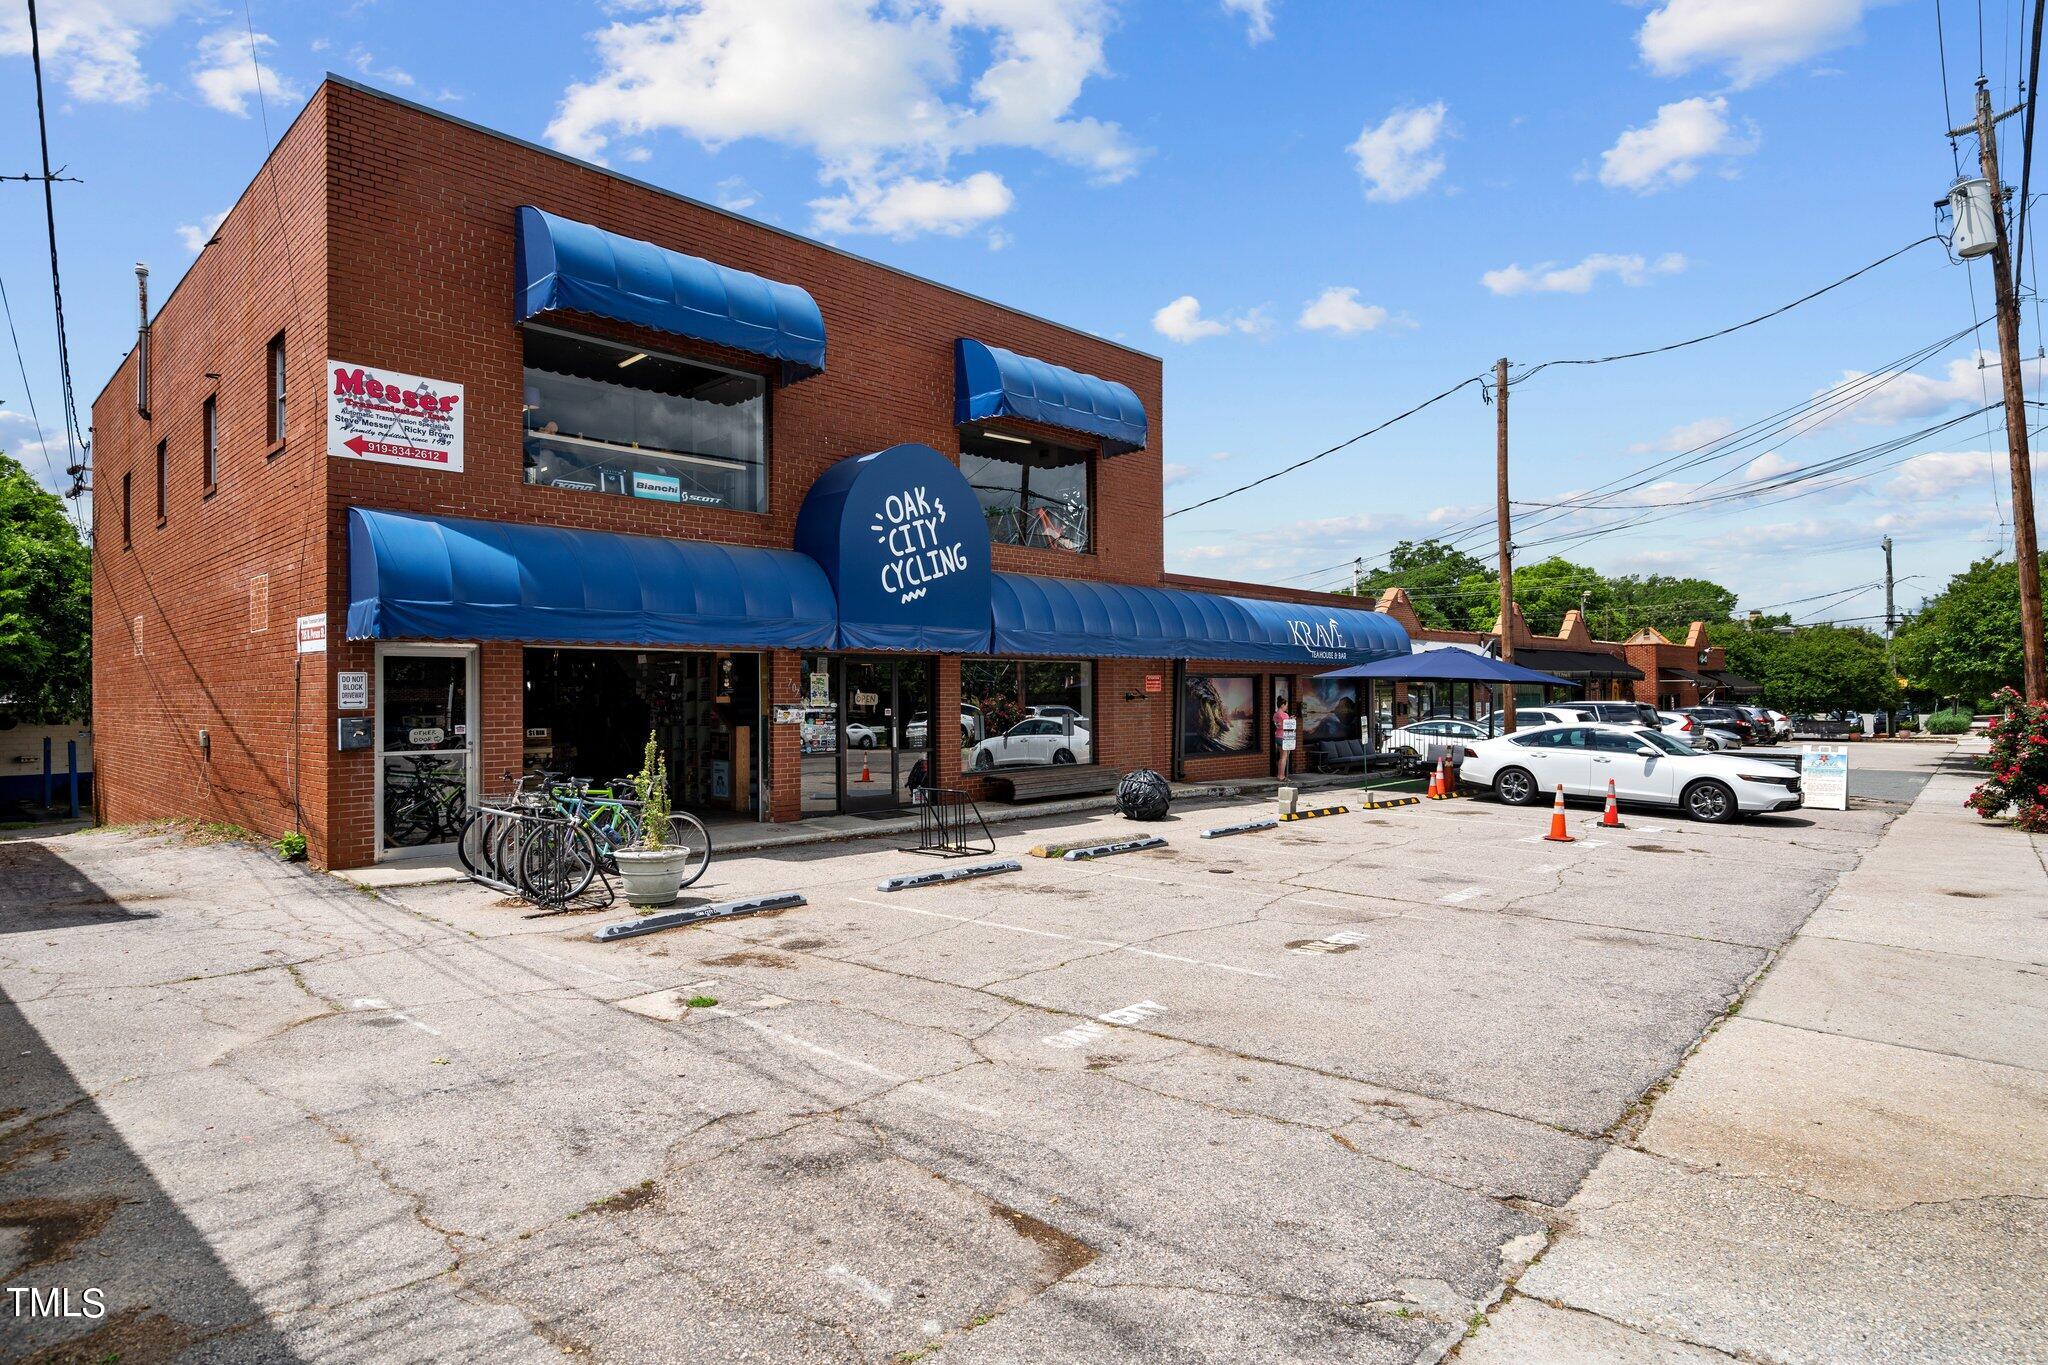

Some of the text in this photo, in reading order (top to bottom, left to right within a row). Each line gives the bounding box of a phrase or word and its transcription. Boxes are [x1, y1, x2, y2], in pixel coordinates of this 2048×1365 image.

[333, 368, 460, 412] Messer
[343, 397, 425, 418] Transmission
[335, 414, 393, 430] Steve Messer
[340, 408, 451, 431] Automatic Transmission Specialists
[350, 426, 376, 437] family
[377, 430, 409, 441] tradition
[410, 436, 428, 444] since
[404, 425, 455, 440] Ricky Brown
[368, 442, 440, 461] 919-834-2612
[636, 481, 679, 494] Bianchi
[689, 494, 722, 504] SCOTT
[885, 486, 931, 523] OAK
[889, 517, 938, 556] CITY
[881, 542, 967, 593] CYCLING
[1287, 618, 1347, 652] KRAVE
[1338, 652, 1347, 660] BAR
[341, 675, 364, 683] DO NOT
[342, 683, 364, 691] BLOCK
[856, 695, 876, 703] OPEN
